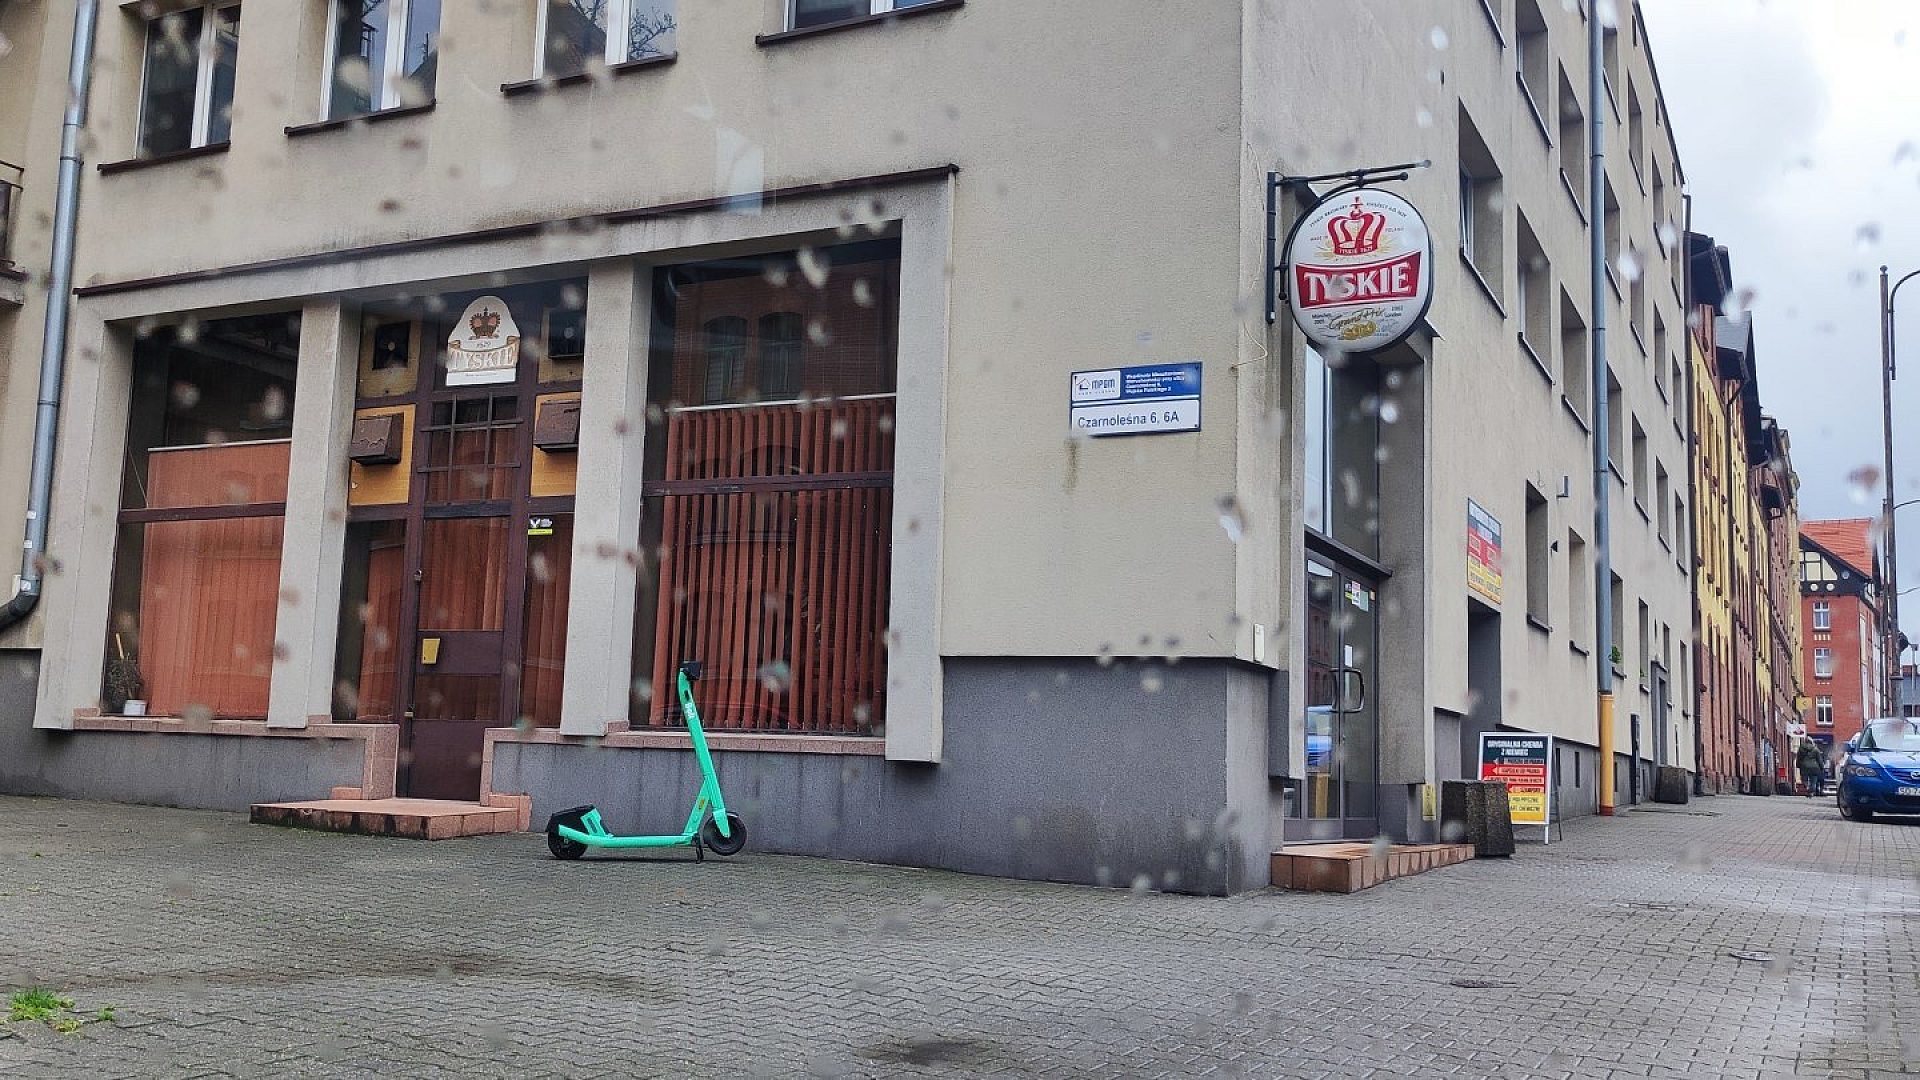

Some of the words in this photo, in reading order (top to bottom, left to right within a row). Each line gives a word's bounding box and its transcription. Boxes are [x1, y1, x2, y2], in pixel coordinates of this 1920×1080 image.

[1303, 263, 1411, 302] TYSKIE
[450, 346, 515, 368] TYSKIE
[1091, 379, 1116, 390] MPGM
[1078, 413, 1146, 428] Czarnoleśna
[1150, 412, 1160, 425] 6,
[1163, 411, 1180, 423] 6A
